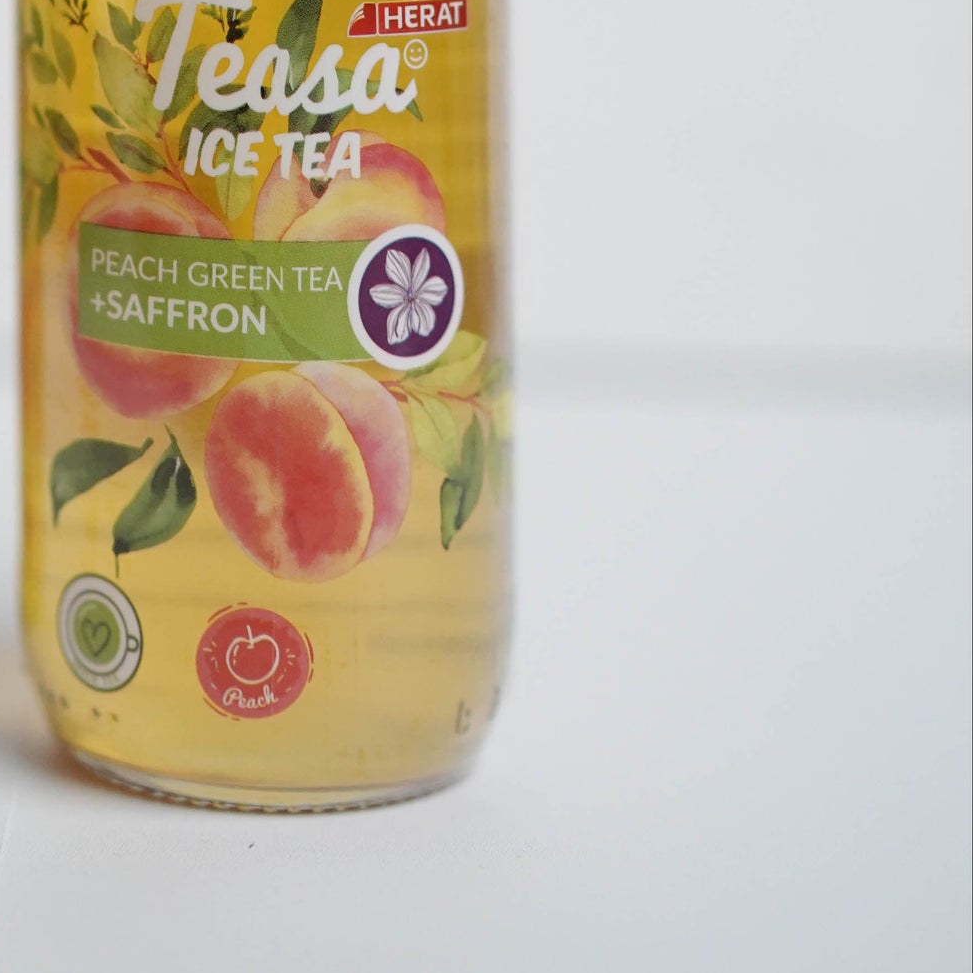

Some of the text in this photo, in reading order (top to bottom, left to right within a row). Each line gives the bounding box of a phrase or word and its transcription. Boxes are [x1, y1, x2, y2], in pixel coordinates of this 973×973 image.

[384, 0, 464, 30] HERAT
[183, 127, 362, 180] ICE TEA
[90, 247, 344, 293] PEACH GREEN TEA
[89, 289, 267, 337] +SAFFRON
[222, 683, 279, 711] Peach
